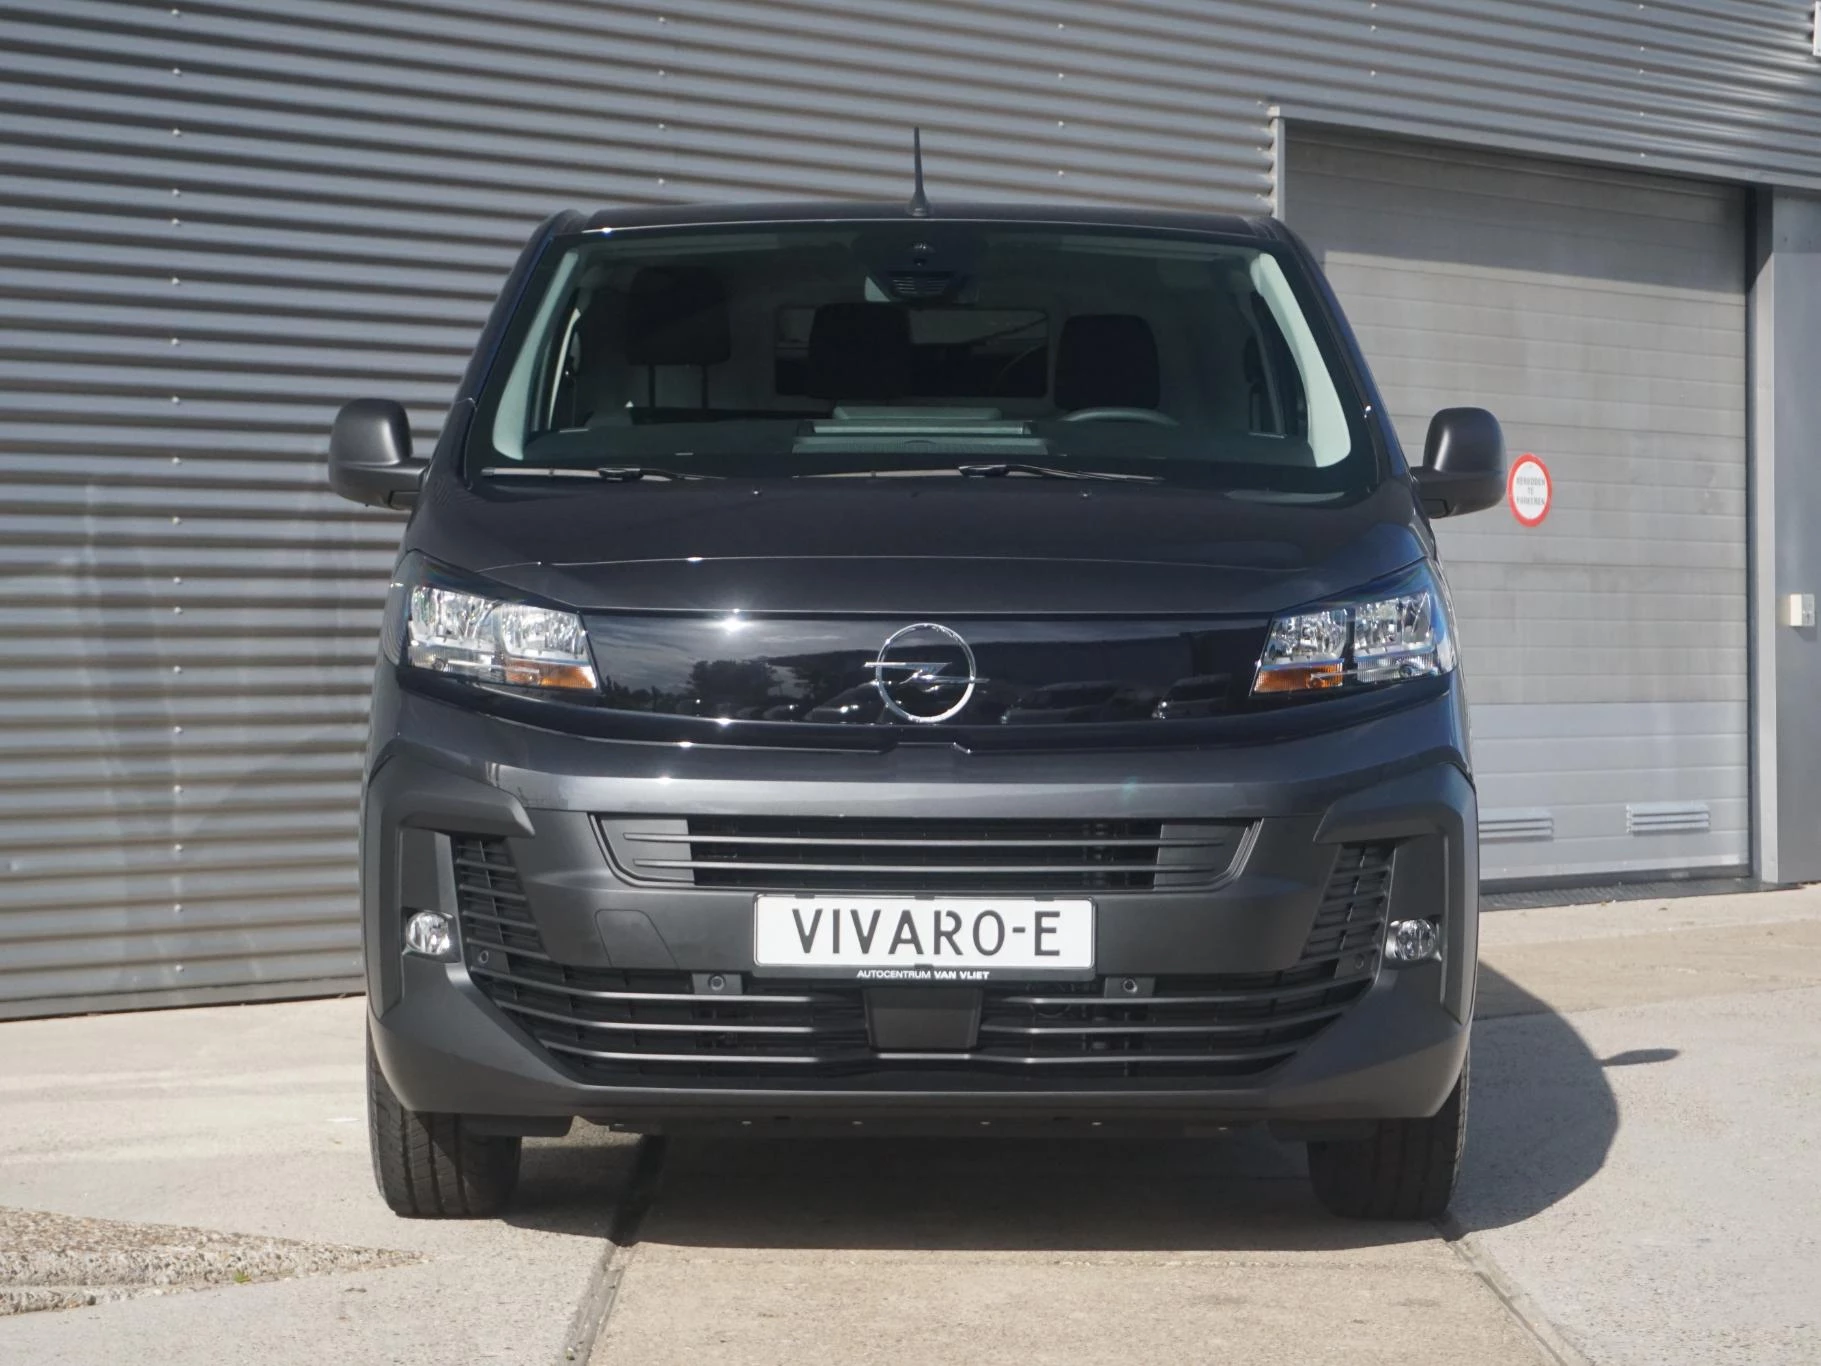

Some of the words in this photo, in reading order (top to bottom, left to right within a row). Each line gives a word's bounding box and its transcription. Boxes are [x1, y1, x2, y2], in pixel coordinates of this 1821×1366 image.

[792, 908, 1061, 957] VIVARO-E
[856, 970, 931, 979] AUTOCENTRUM
[934, 970, 956, 979] VAN
[959, 970, 990, 980] VLIET
